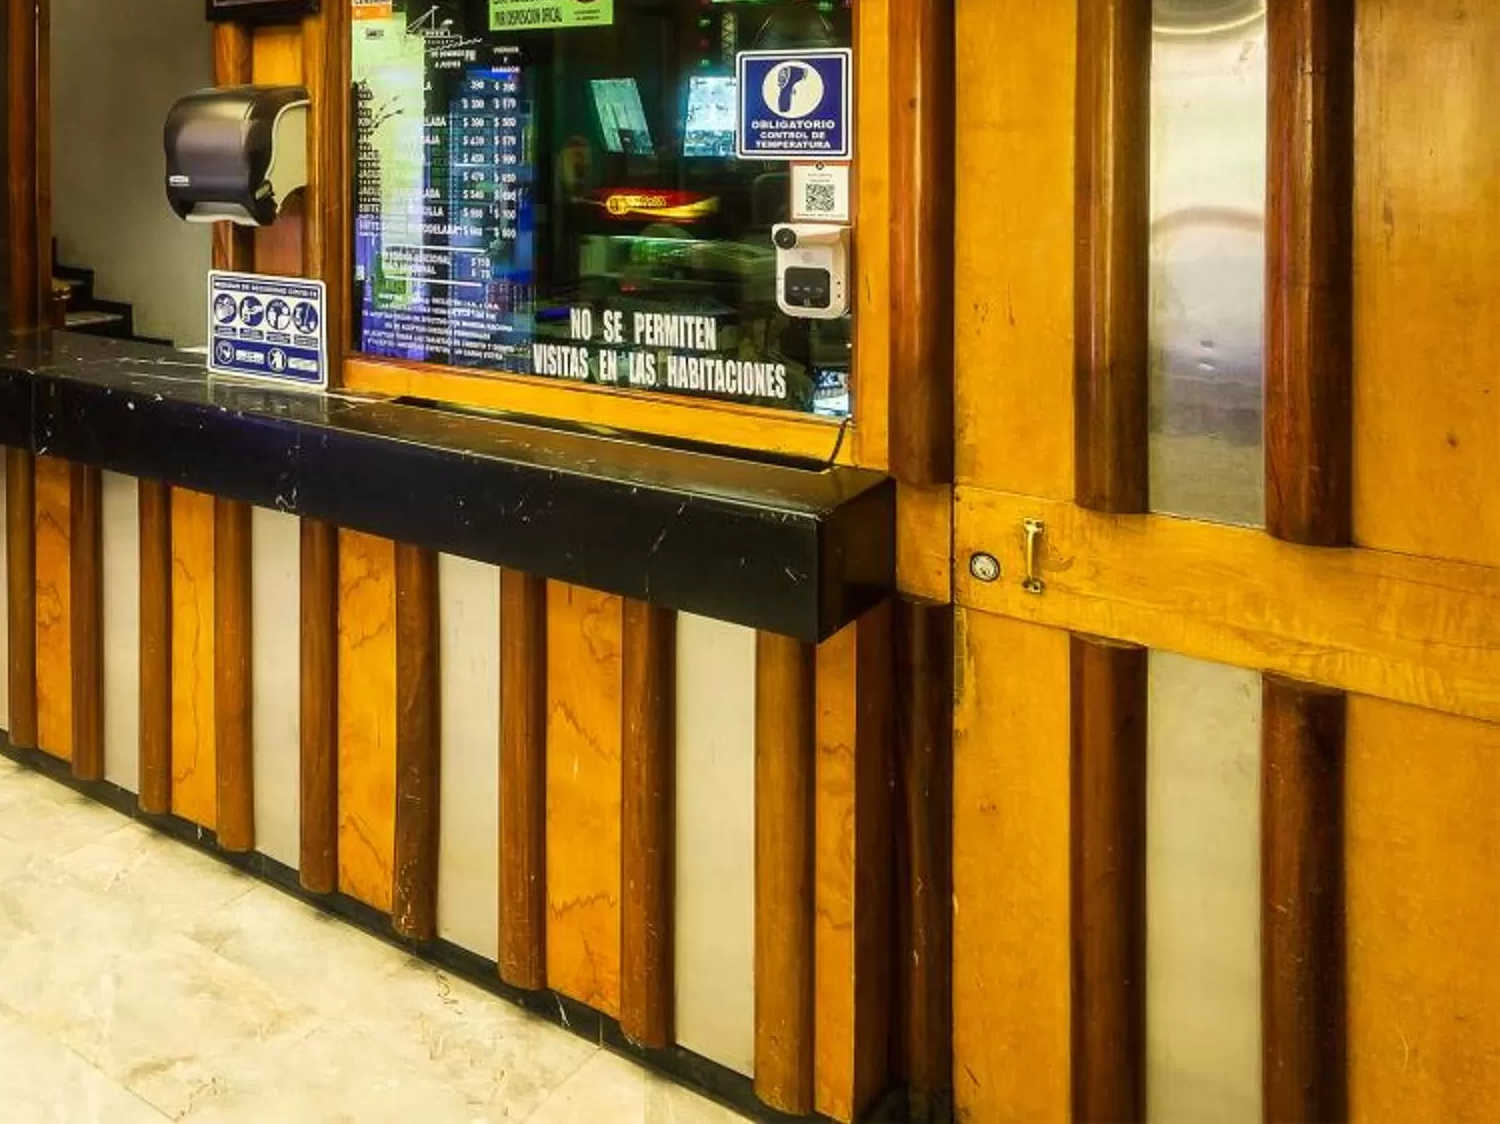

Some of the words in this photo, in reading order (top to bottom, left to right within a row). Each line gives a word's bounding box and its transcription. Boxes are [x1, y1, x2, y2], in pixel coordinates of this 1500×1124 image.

[751, 119, 836, 130] OBLIGATORIO
[759, 131, 809, 139] CONTROL
[811, 131, 826, 139] DE
[755, 140, 832, 149] TEMPERATURA
[570, 307, 592, 341] NO
[603, 309, 624, 343] SE
[633, 312, 717, 350] PERMITEN
[532, 343, 589, 379] VISITAS
[600, 349, 617, 382] EN
[629, 352, 657, 386] LAS
[667, 355, 787, 399] HABITACIONES
